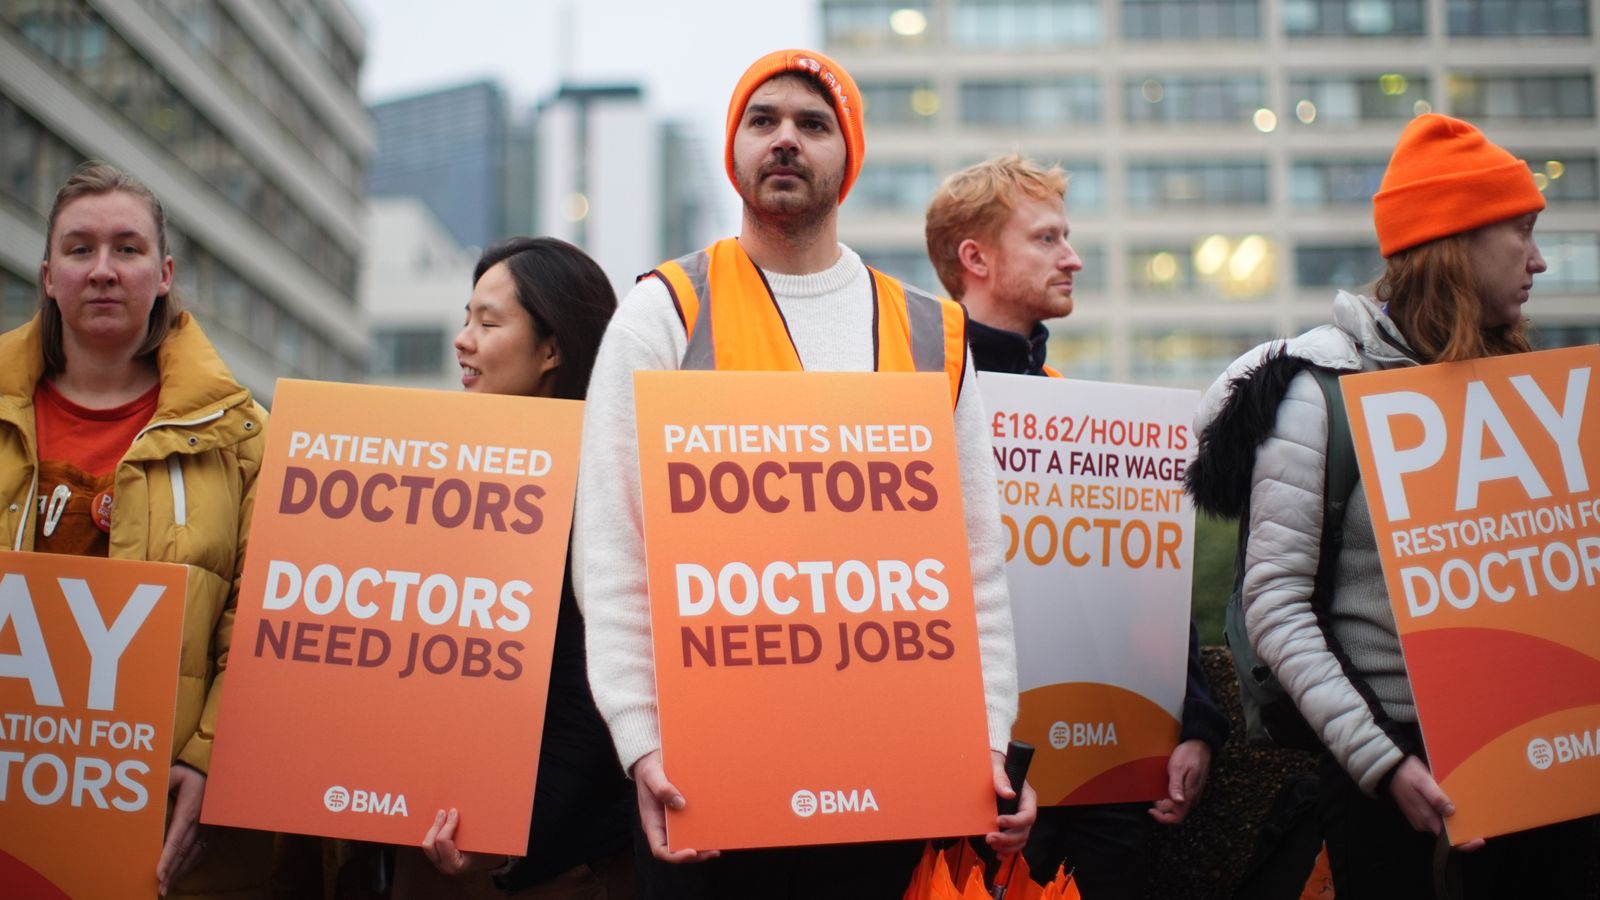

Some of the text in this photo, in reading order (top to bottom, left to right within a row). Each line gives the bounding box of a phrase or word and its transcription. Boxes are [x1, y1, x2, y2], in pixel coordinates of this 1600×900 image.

[664, 424, 932, 453] PATIENTS NEED
[992, 411, 1188, 450] £18.62/HOUR IS
[1360, 367, 1591, 522] PAY
[288, 431, 552, 477] PATIENTS NEED
[992, 446, 1187, 482] NOT A FAIR WAGE
[278, 466, 547, 535] DOCTORS
[667, 460, 938, 514] DOCTORS
[1046, 483, 1063, 507] A
[1070, 484, 1184, 513] RESIDENT
[1391, 503, 1575, 557] RESTORATION
[261, 560, 534, 633] DOCTORS
[675, 558, 950, 616] DOCTORS
[254, 619, 526, 681] NEED JOBS
[680, 619, 956, 672] NEED JOBS
[90, 720, 155, 751] FOR
[1073, 722, 1118, 747] BMA
[1553, 729, 1600, 763] BM
[351, 790, 409, 817] BMA
[820, 789, 879, 814] BMA
